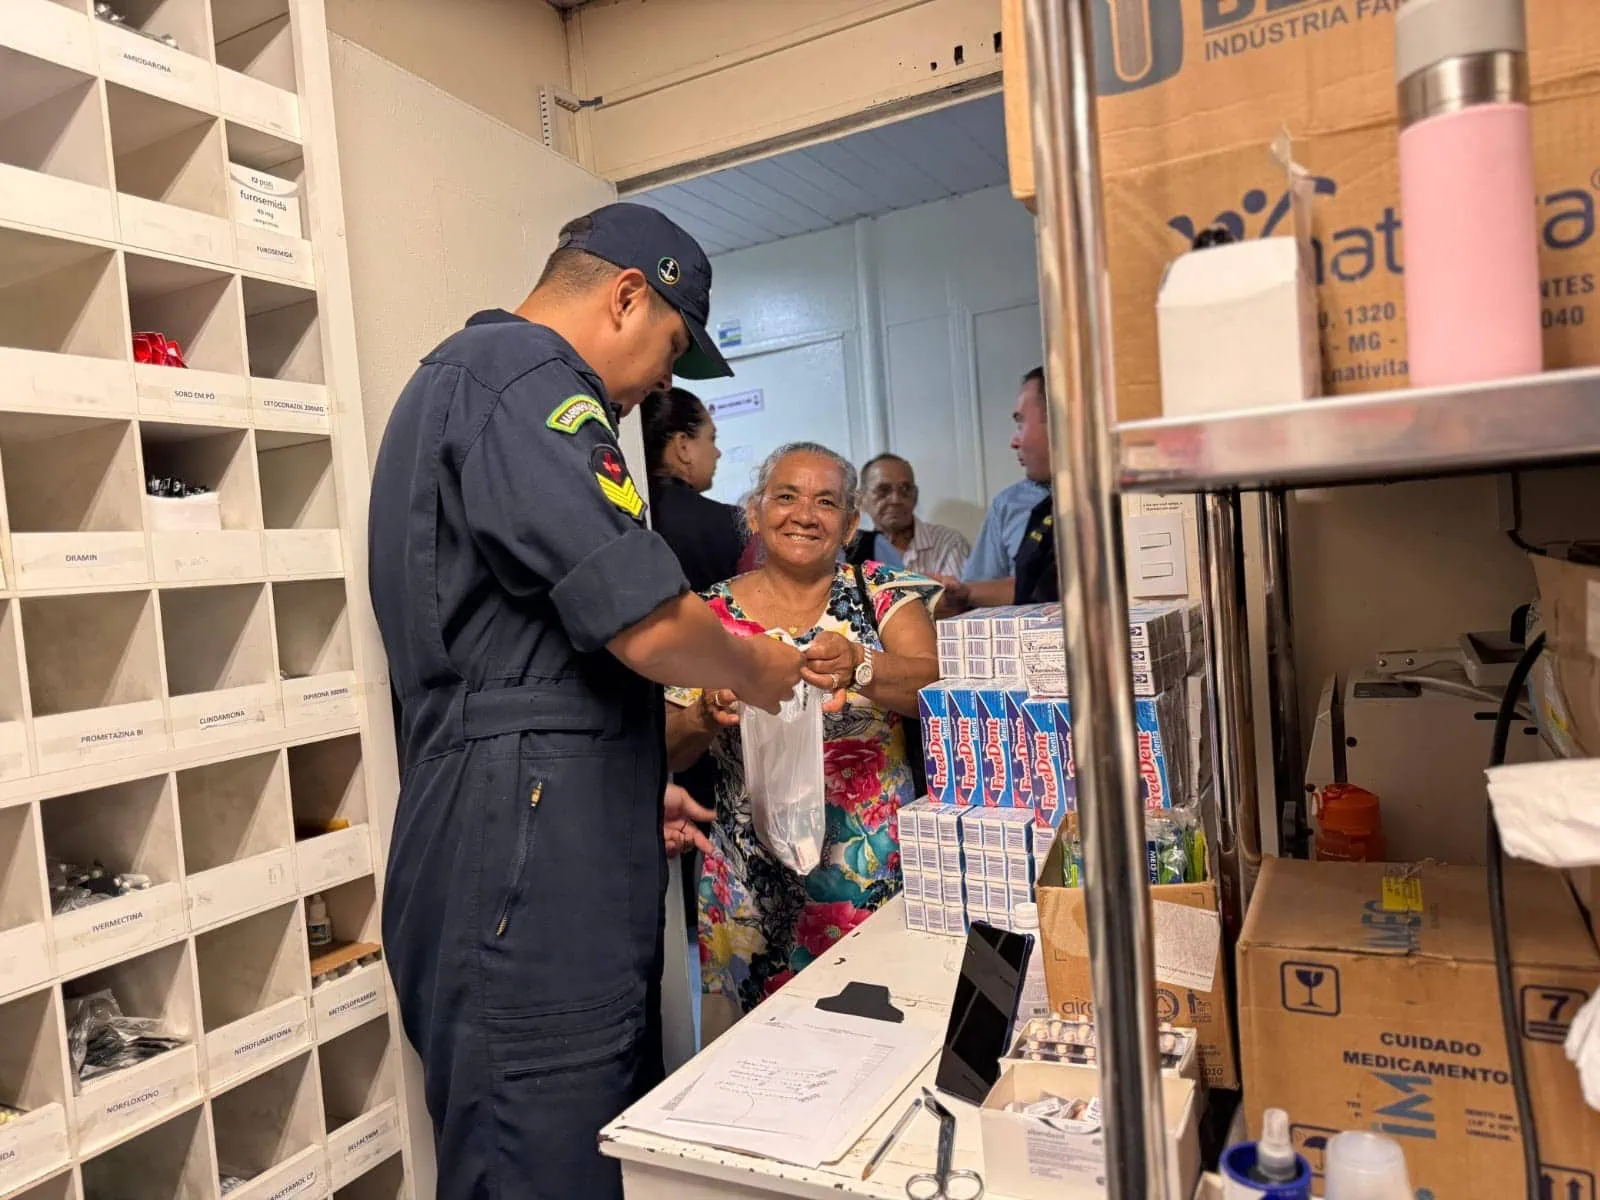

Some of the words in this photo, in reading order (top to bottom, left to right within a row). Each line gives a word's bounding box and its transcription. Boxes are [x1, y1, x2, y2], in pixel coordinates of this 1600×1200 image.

[1356, 0, 1401, 20] FA
[240, 189, 287, 212] furosemida
[256, 245, 293, 258] FUROSEMIDA
[1344, 302, 1396, 327] 1320
[1348, 331, 1381, 353] MG
[174, 390, 193, 399] SORO
[194, 392, 205, 400] EM
[65, 553, 98, 563] DRAMIN
[80, 730, 136, 743] PROMETAZINA
[970, 718, 978, 740] Menta
[929, 717, 947, 787] FreeDent
[958, 718, 976, 788] FreeDent
[986, 718, 1005, 790] FreeDent
[1049, 732, 1058, 757] Menta
[1152, 731, 1162, 757] Menta
[1035, 732, 1057, 810] FreeDent
[1138, 732, 1162, 809] FreeDent
[92, 911, 143, 932] IVERMECTINA
[233, 1027, 293, 1056] NITROFURANTOINA
[1380, 1032, 1482, 1057] CUIDADO
[1343, 1051, 1512, 1086] MEDICAMENTO
[106, 1089, 160, 1113] NORFLOXCINO
